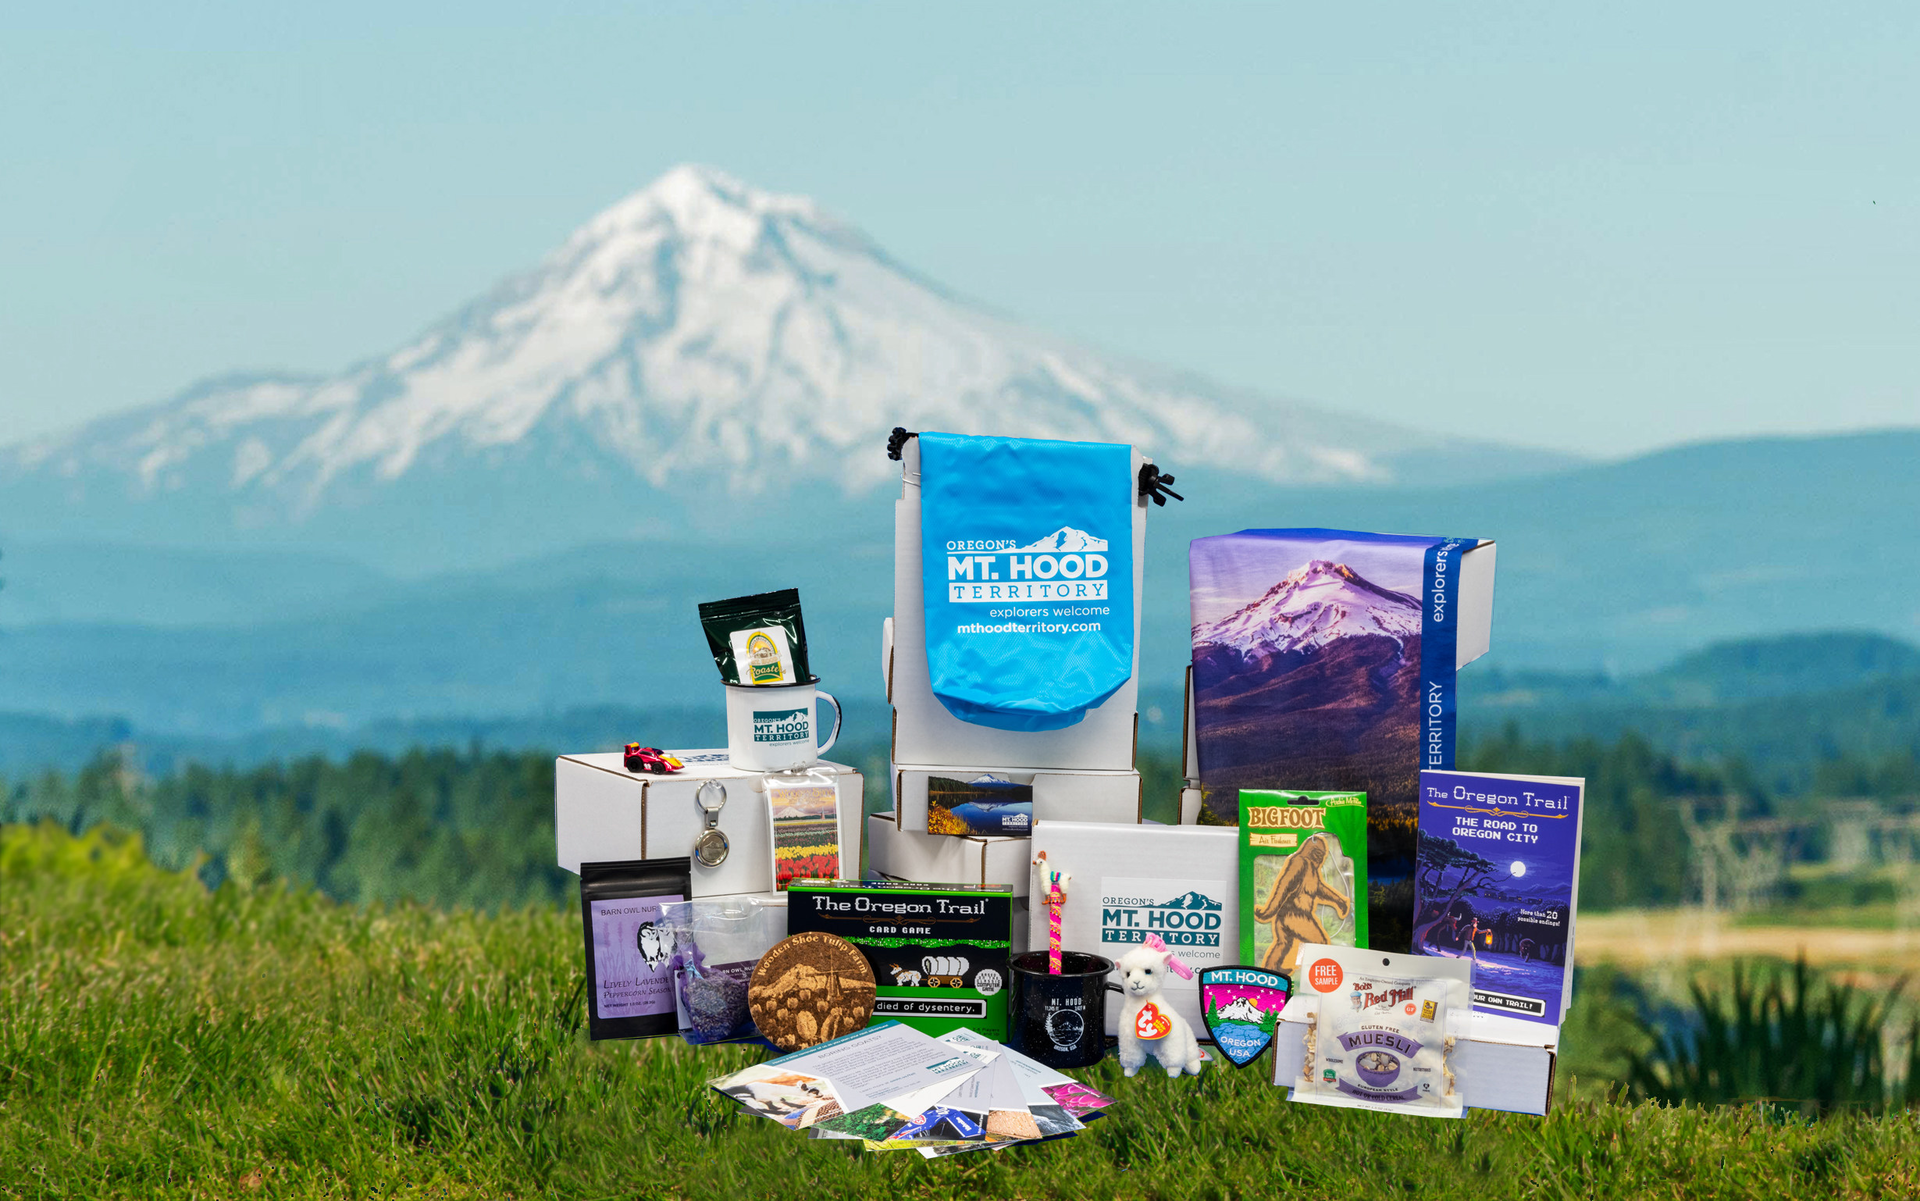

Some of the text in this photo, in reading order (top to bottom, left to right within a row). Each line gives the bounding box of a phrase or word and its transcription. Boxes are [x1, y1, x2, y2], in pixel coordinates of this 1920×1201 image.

[946, 540, 1017, 550] OREGON'S
[948, 554, 1108, 580] MT. HOOD
[954, 584, 1104, 599] TERRITORY
[1432, 549, 1448, 622] explorers
[990, 606, 1110, 618] explorers welcome
[958, 622, 1102, 634] mthoodterritory.com
[754, 721, 809, 734] MT. HOOD
[755, 732, 809, 741] TERRITORY
[1427, 786, 1568, 810] The Oregon Trail
[1247, 806, 1326, 830] BIGFOOT
[1456, 816, 1538, 833] THE ROAD TO
[1452, 827, 1538, 844] OREGON CITY
[812, 895, 986, 915] The Oregon Trail
[1102, 896, 1155, 906] OREGON'S
[1102, 908, 1222, 930] MT. HOOD
[1546, 910, 1558, 920] 20
[869, 926, 932, 936] CARD GAME
[758, 942, 790, 977] Wooden
[792, 935, 819, 946] Shoe
[822, 935, 848, 952] Tulip
[848, 949, 868, 974] Farm
[1178, 950, 1220, 958] welcome
[1314, 964, 1336, 976] FREE
[636, 977, 672, 987] LAVENDE
[1211, 972, 1278, 987] MT. HOOD
[1314, 977, 1338, 986] SAMPLE
[648, 987, 672, 996] SEASON
[1066, 998, 1082, 1006] HOOD
[1363, 990, 1388, 1010] Red
[1388, 986, 1414, 1007] Mill
[877, 1002, 976, 1014] died of dysentery.
[1506, 1000, 1534, 1010] TRAIL!
[1138, 1010, 1158, 1037] ty
[1220, 1036, 1262, 1048] OREGON
[1348, 1033, 1412, 1054] MUESLI
[1228, 1048, 1251, 1058] USA
[1358, 1084, 1382, 1092] EUROPEAN
[1386, 1094, 1406, 1102] CEREAL
